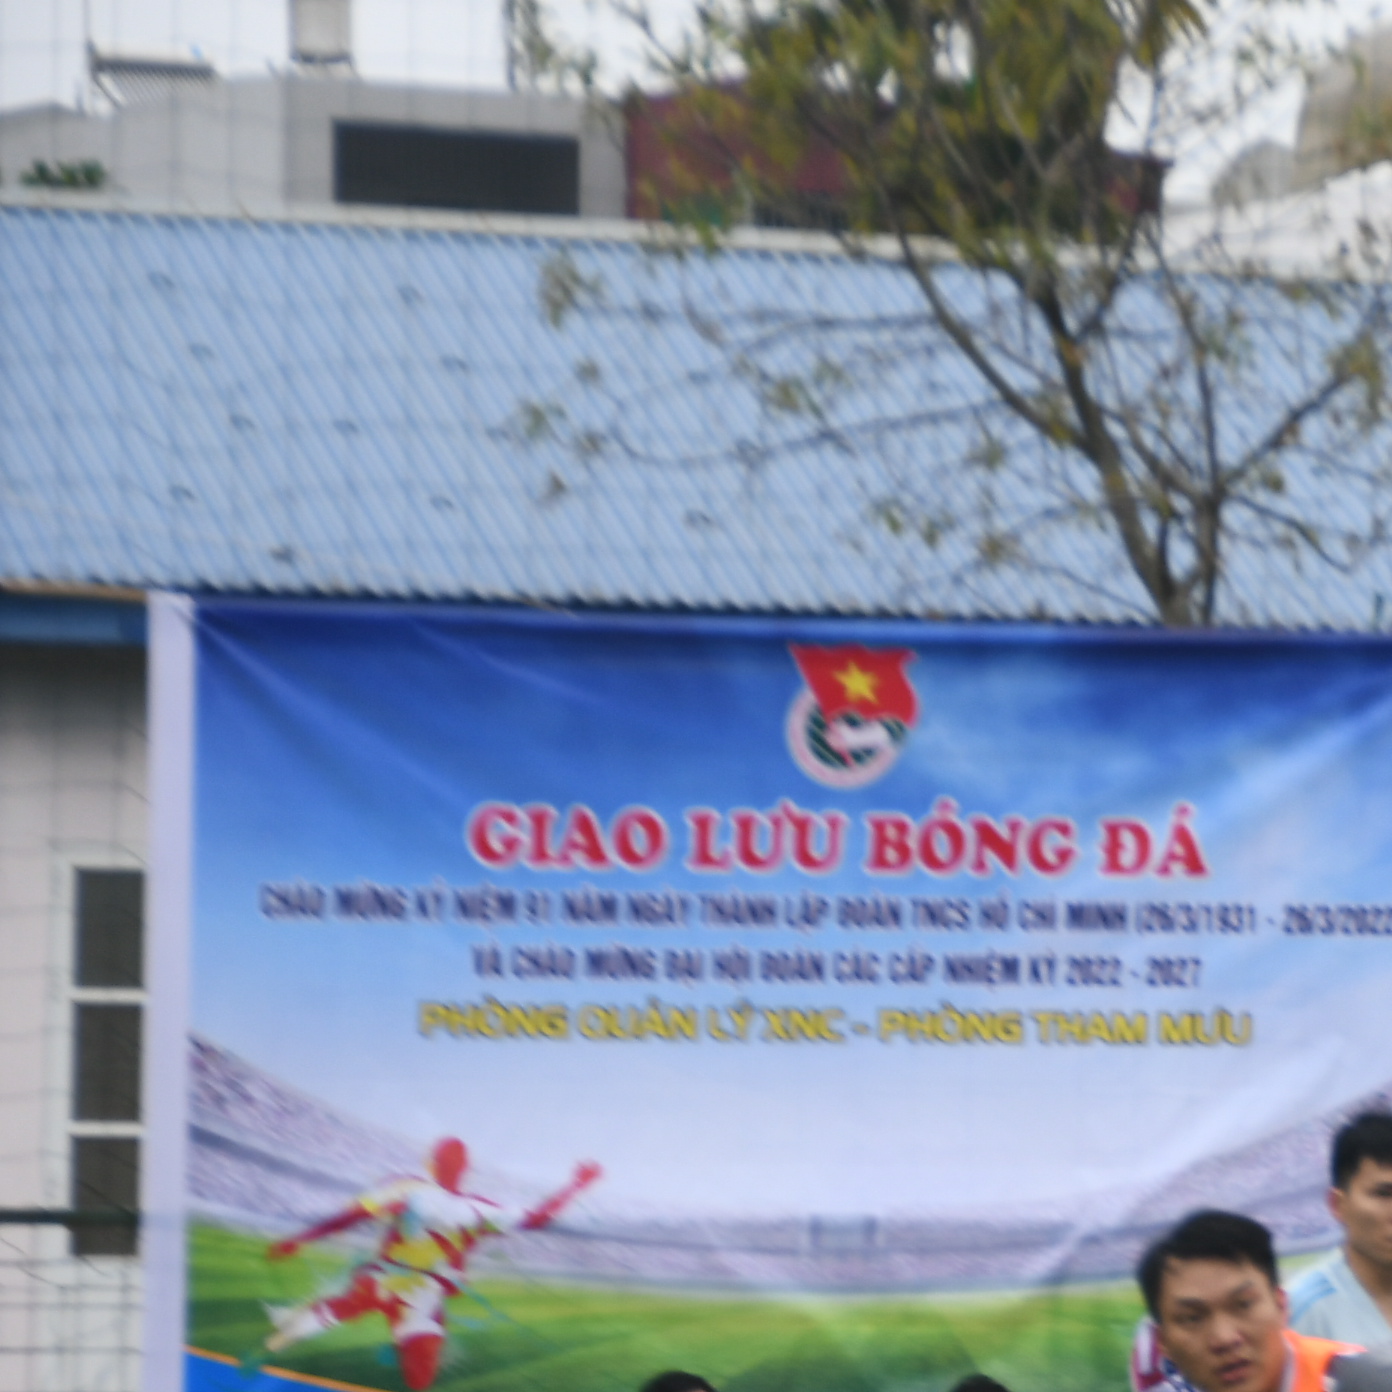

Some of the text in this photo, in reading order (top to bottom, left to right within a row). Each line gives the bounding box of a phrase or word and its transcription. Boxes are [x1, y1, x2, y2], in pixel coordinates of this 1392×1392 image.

[467, 801, 668, 870] GIAO
[684, 798, 847, 874] LƯU
[760, 1005, 847, 1045] XNC
[1030, 1008, 1149, 1046] THAM
